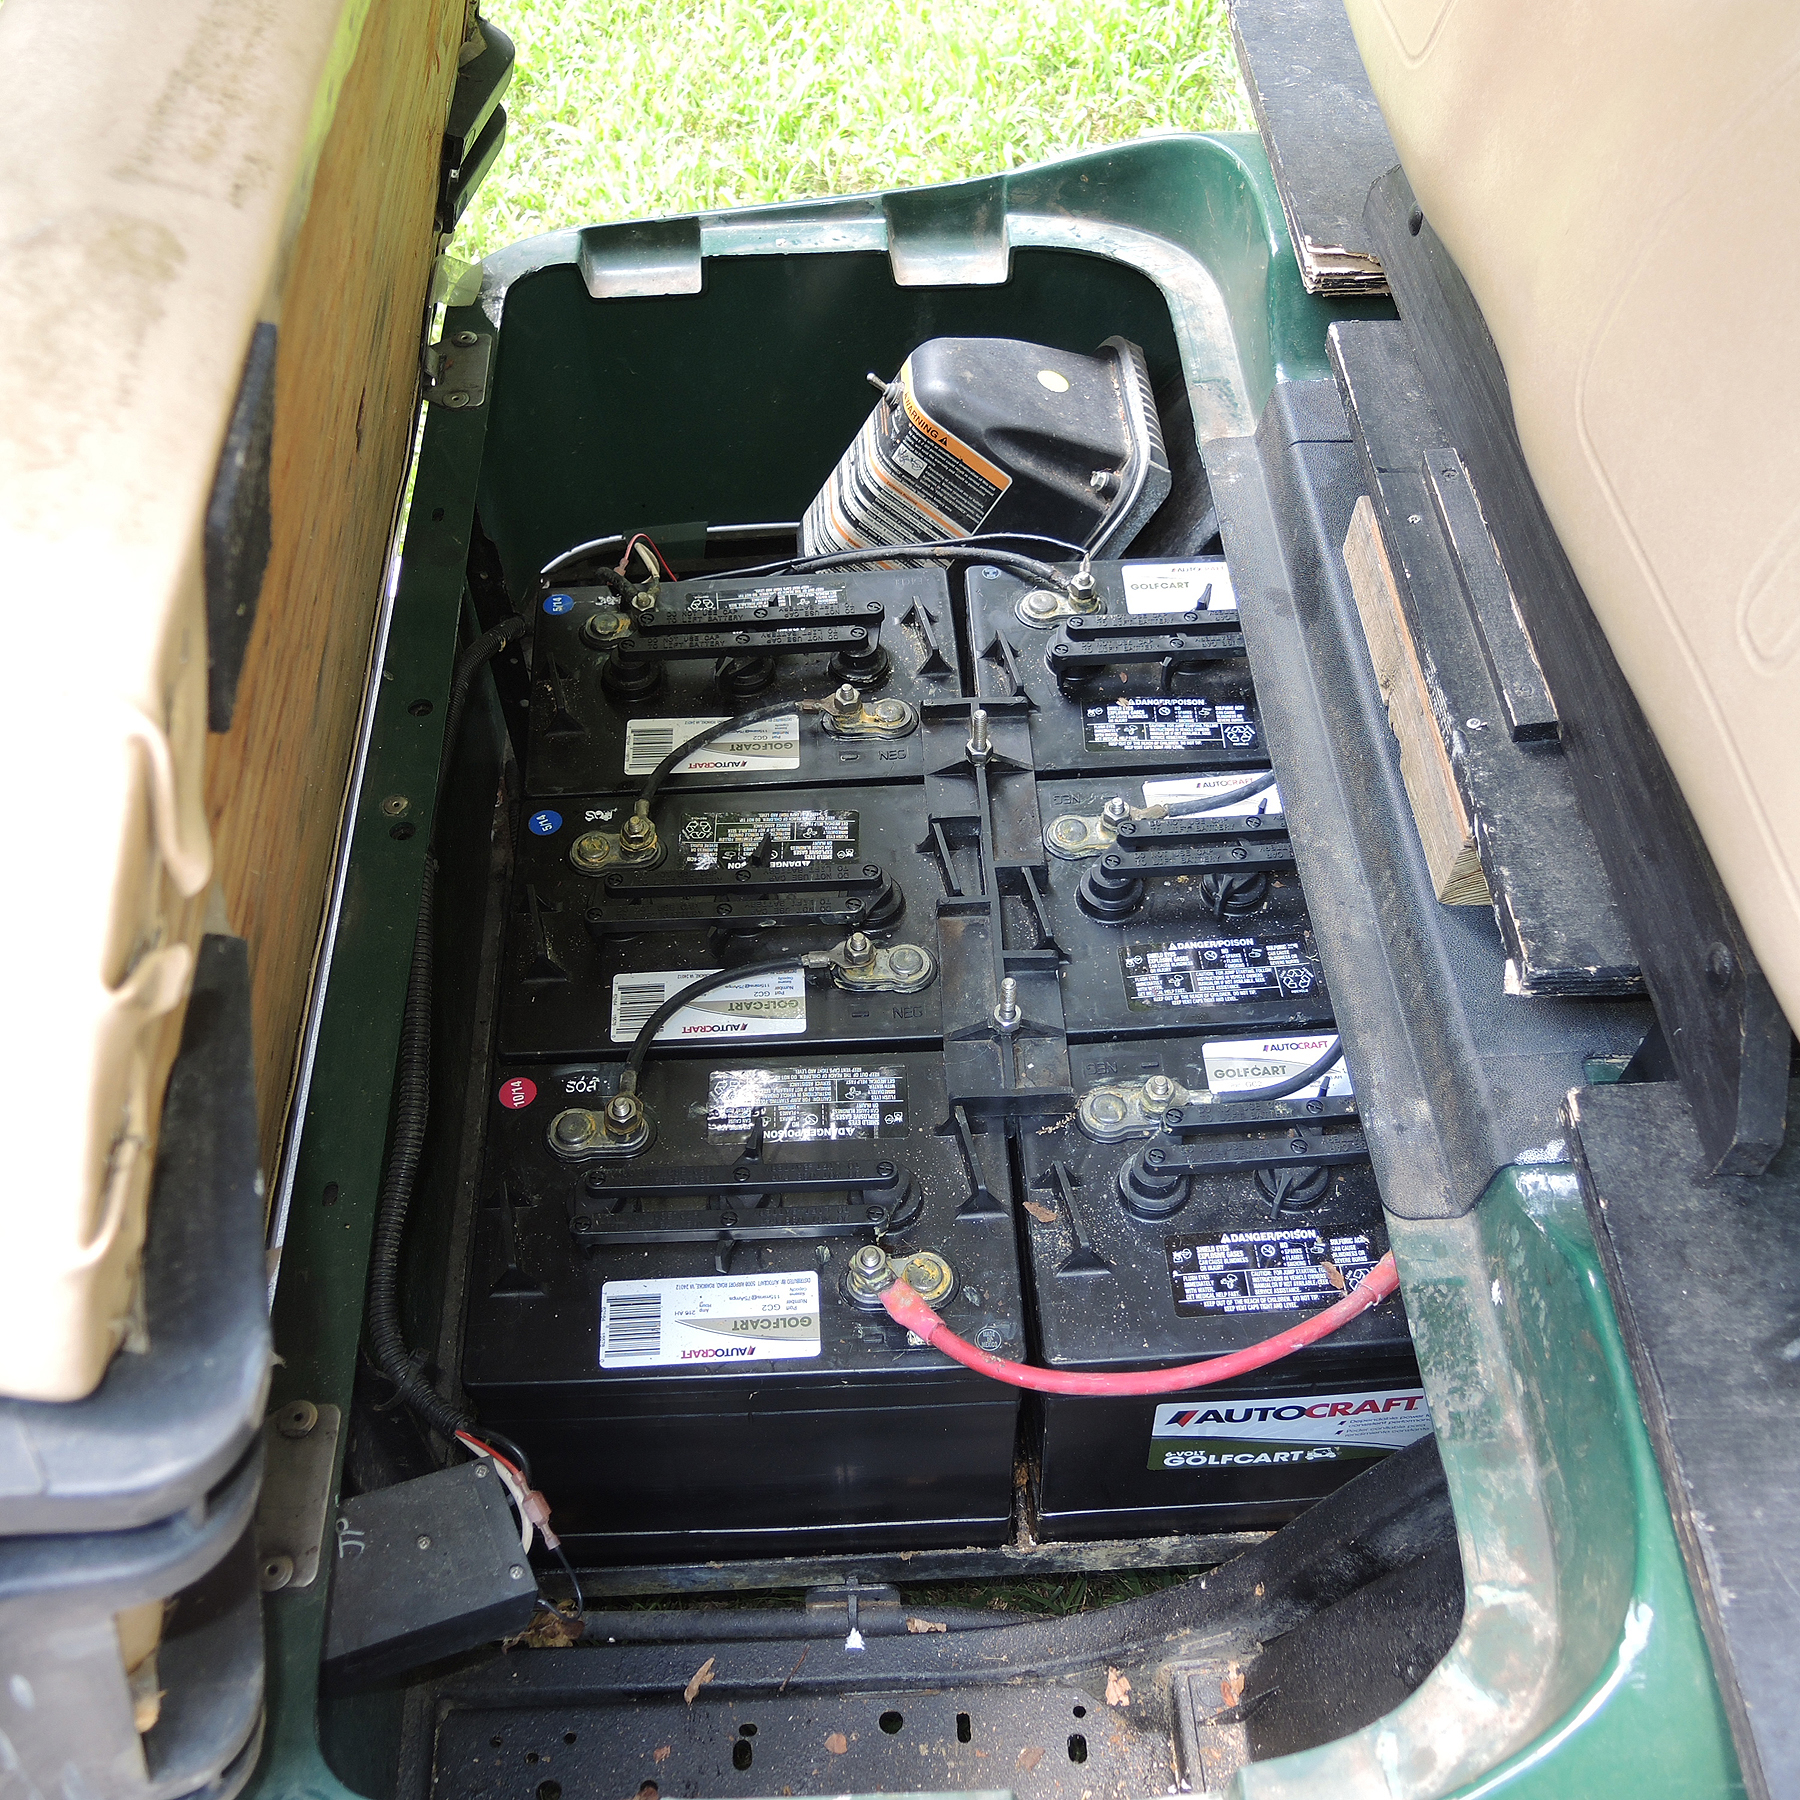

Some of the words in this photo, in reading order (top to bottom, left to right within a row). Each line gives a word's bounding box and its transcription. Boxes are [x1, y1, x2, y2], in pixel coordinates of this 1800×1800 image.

[1131, 582, 1189, 591] GOLFCART
[729, 742, 793, 751] GOLFCART
[688, 760, 741, 769] AUTOCRAFT
[1203, 778, 1253, 788] AUTOCRAFT
[536, 815, 552, 832] 5/14
[1177, 938, 1254, 950] DANGER/POISON
[727, 1000, 799, 1011] GOLFCART
[893, 1006, 923, 1018] NEG
[681, 1023, 741, 1034] AUTOCRAFT
[1270, 1041, 1328, 1052] AUTOCRAFT
[1214, 1065, 1286, 1079] GOLFCART
[511, 1080, 525, 1107] 10/14
[1230, 1229, 1317, 1242] DANGER/POISON
[731, 1315, 812, 1331] GOLFCART
[681, 1347, 747, 1359] AUTOCRAFT
[1194, 1396, 1425, 1425] AUTOCRAFT
[1163, 1451, 1304, 1468] GOLFCART
[1165, 1450, 1206, 1459] 6-VOLT
